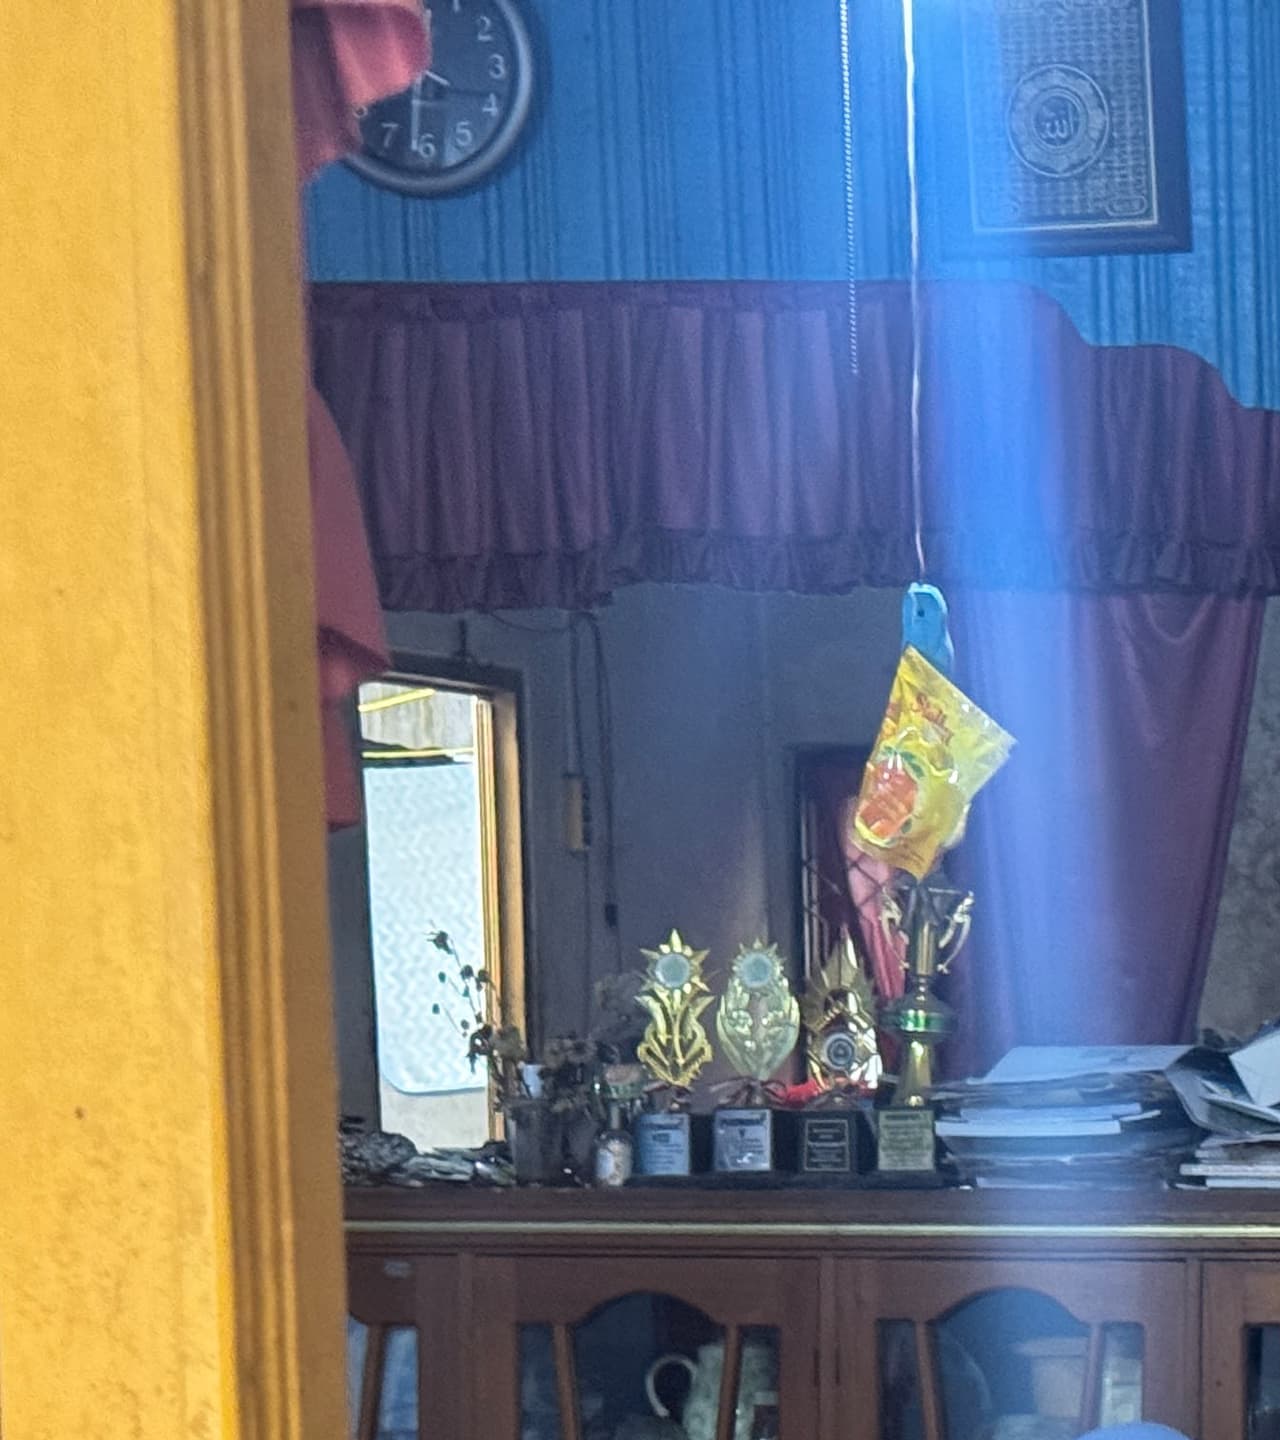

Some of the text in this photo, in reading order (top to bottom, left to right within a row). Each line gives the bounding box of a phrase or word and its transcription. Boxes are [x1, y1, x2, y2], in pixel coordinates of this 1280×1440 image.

[476, 15, 494, 42] 2
[488, 53, 506, 80] 3
[481, 92, 498, 117] 4
[381, 122, 400, 148] 7
[418, 132, 436, 158] 6
[455, 120, 474, 147] 5
